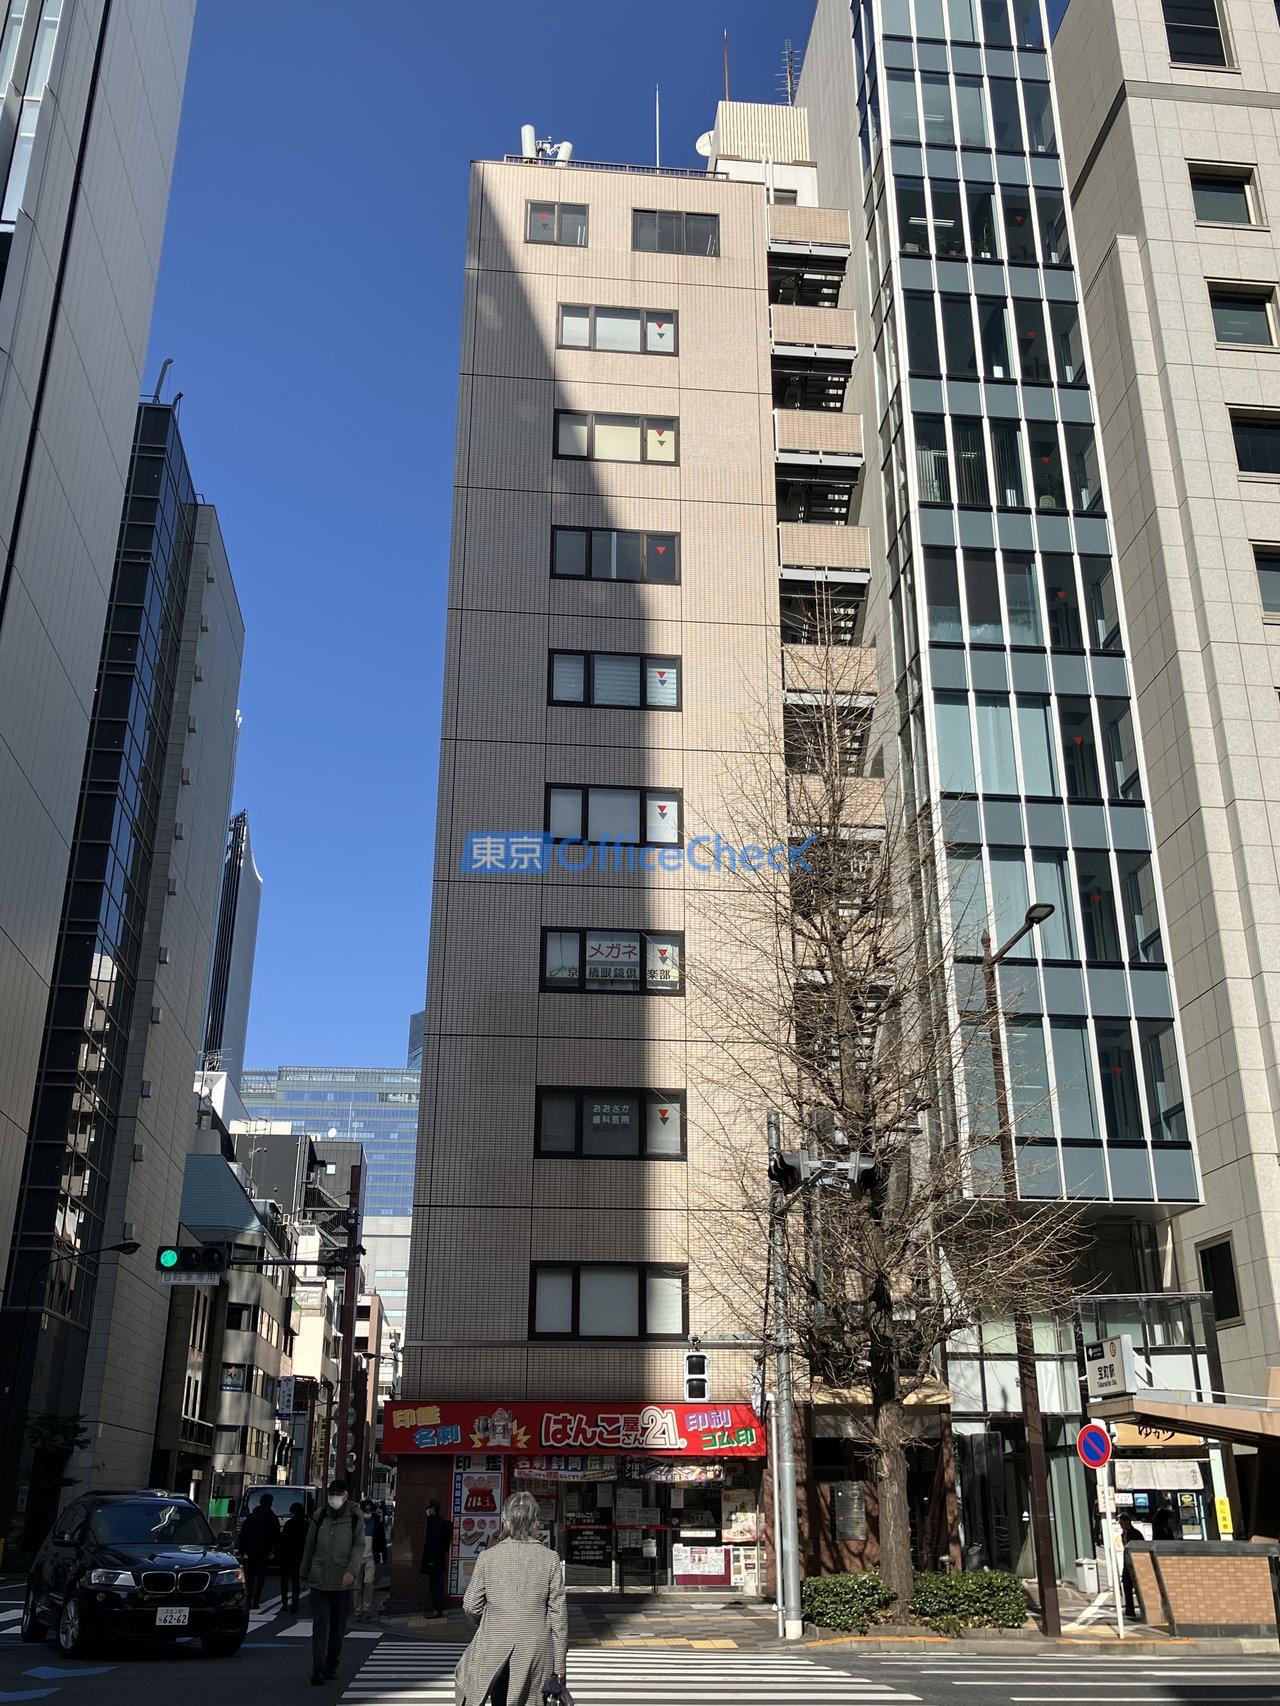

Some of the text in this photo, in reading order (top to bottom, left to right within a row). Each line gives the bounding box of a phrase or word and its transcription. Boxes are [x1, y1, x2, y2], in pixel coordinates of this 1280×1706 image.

[589, 942, 638, 960] メガネ
[592, 1104, 631, 1113] おおさか
[592, 1115, 631, 1124] 歯科医院
[392, 1405, 441, 1429] 印鑑
[684, 1407, 733, 1432] 印刷
[413, 1424, 462, 1449] 名刺
[701, 1427, 757, 1451] ゴム印
